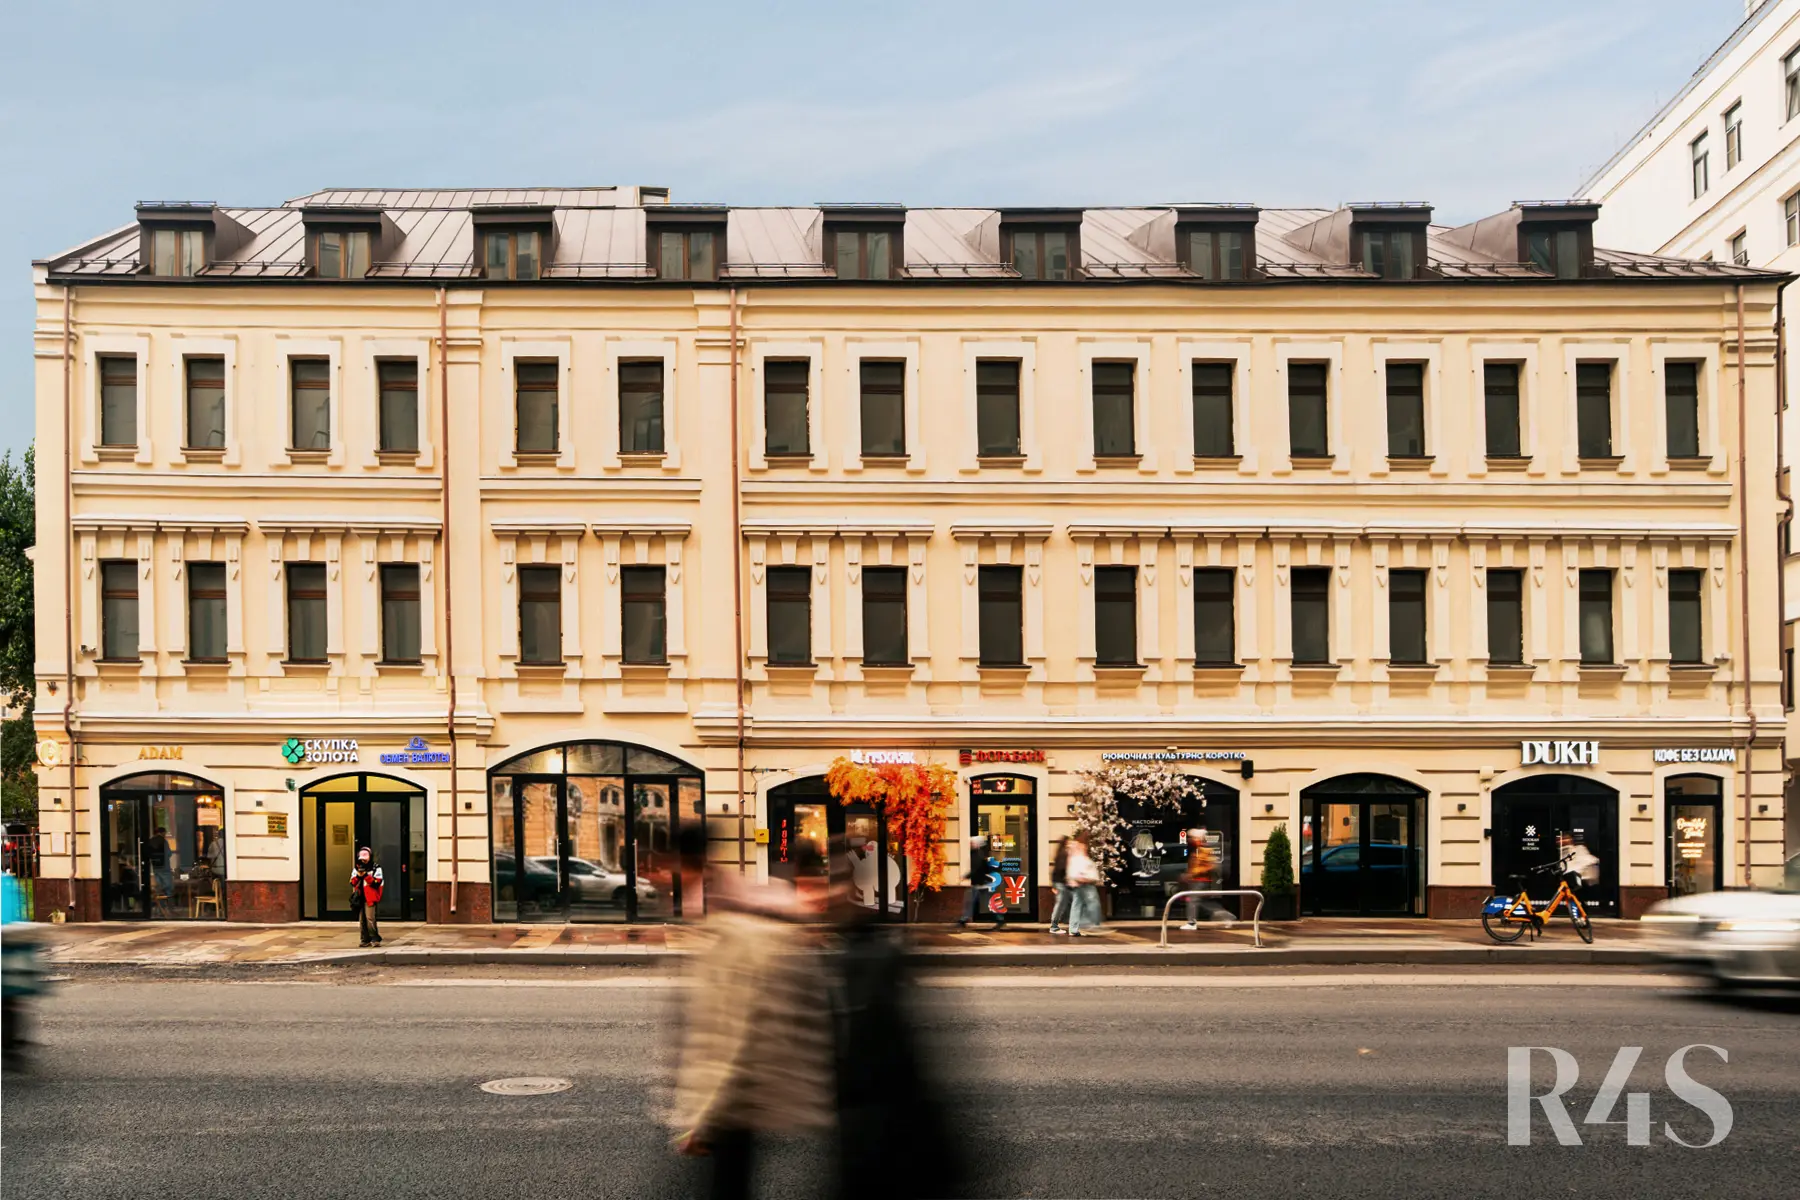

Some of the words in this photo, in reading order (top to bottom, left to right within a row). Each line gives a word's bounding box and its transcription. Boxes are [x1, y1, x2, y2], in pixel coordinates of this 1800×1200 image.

[304, 739, 359, 750] СКУПКА
[138, 746, 184, 760] ADAM
[304, 751, 359, 763] ЗОЛОТА
[379, 753, 409, 764] ОБМЕН
[411, 752, 450, 764] ВАЛЮТЫ
[1155, 752, 1204, 760] КУЛЬТУРНО
[1521, 741, 1600, 765] DUKH
[1654, 749, 1679, 762] КОФЕ
[1681, 749, 1699, 762] БЕЗ
[1701, 748, 1736, 762] САХАРА
